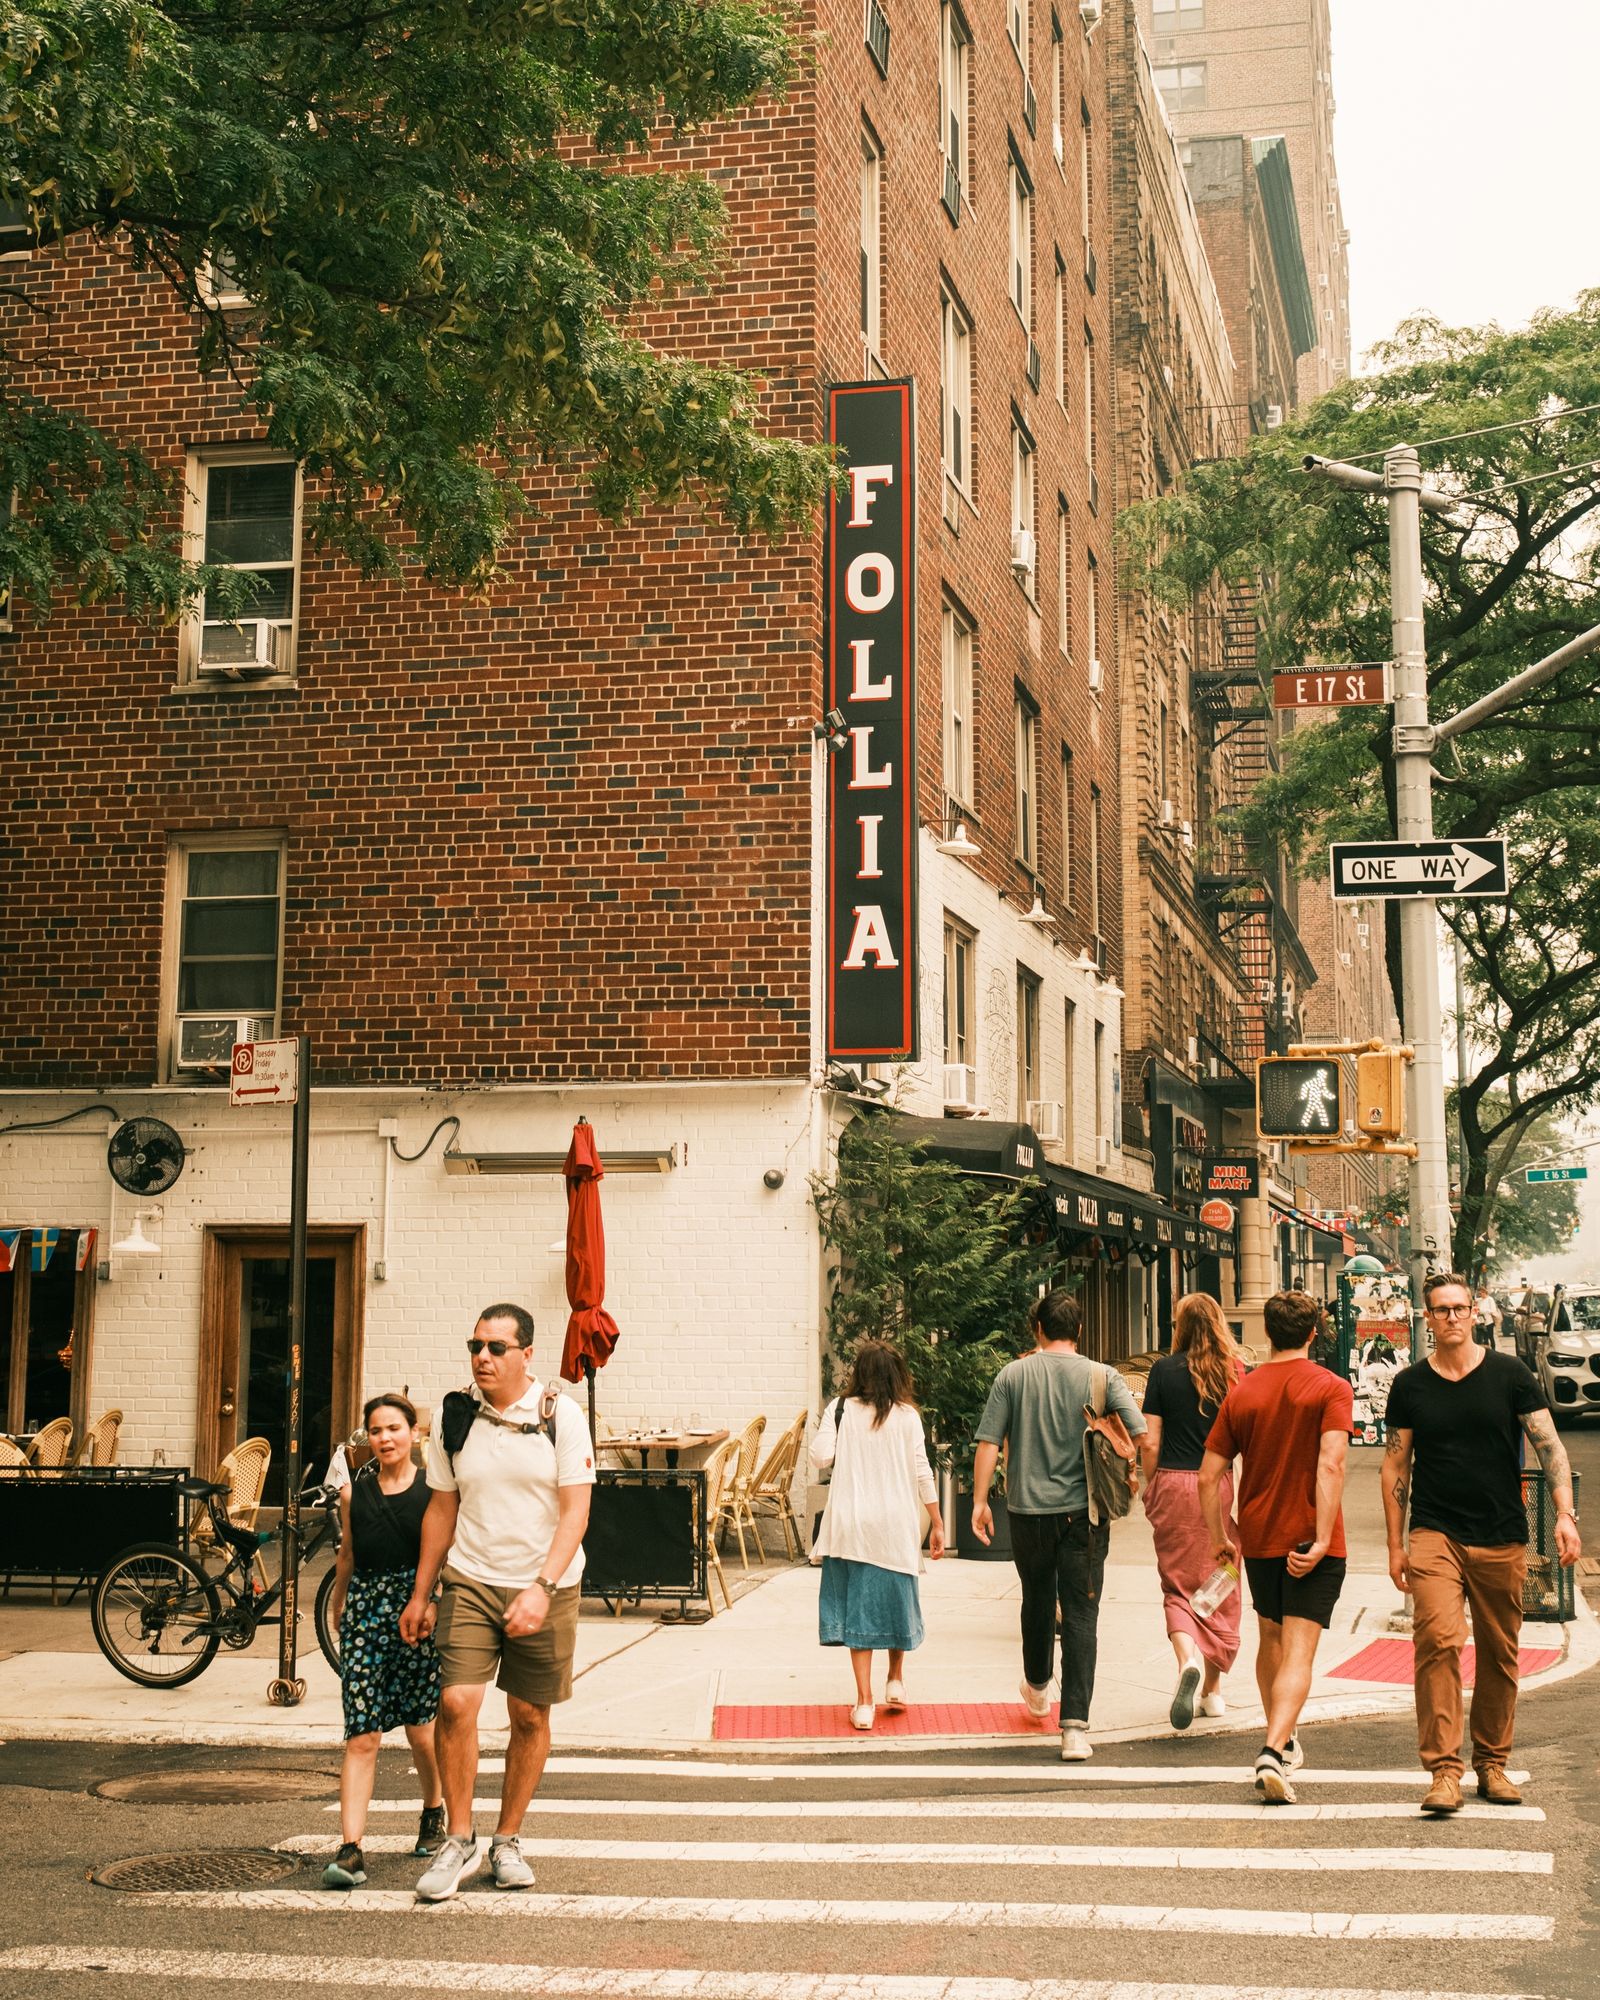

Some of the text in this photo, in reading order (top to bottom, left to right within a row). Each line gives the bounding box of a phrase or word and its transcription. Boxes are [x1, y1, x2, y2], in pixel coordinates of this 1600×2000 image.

[1296, 675, 1366, 703] E 17 St
[841, 463, 899, 969] FOLLIA
[1352, 858, 1470, 880] ONE WAY
[256, 1049, 276, 1059] Tuesday
[255, 1059, 271, 1068] Friday
[1213, 1165, 1247, 1178] MINI
[1544, 1170, 1570, 1179] E 16 St
[1208, 1178, 1251, 1190] MART
